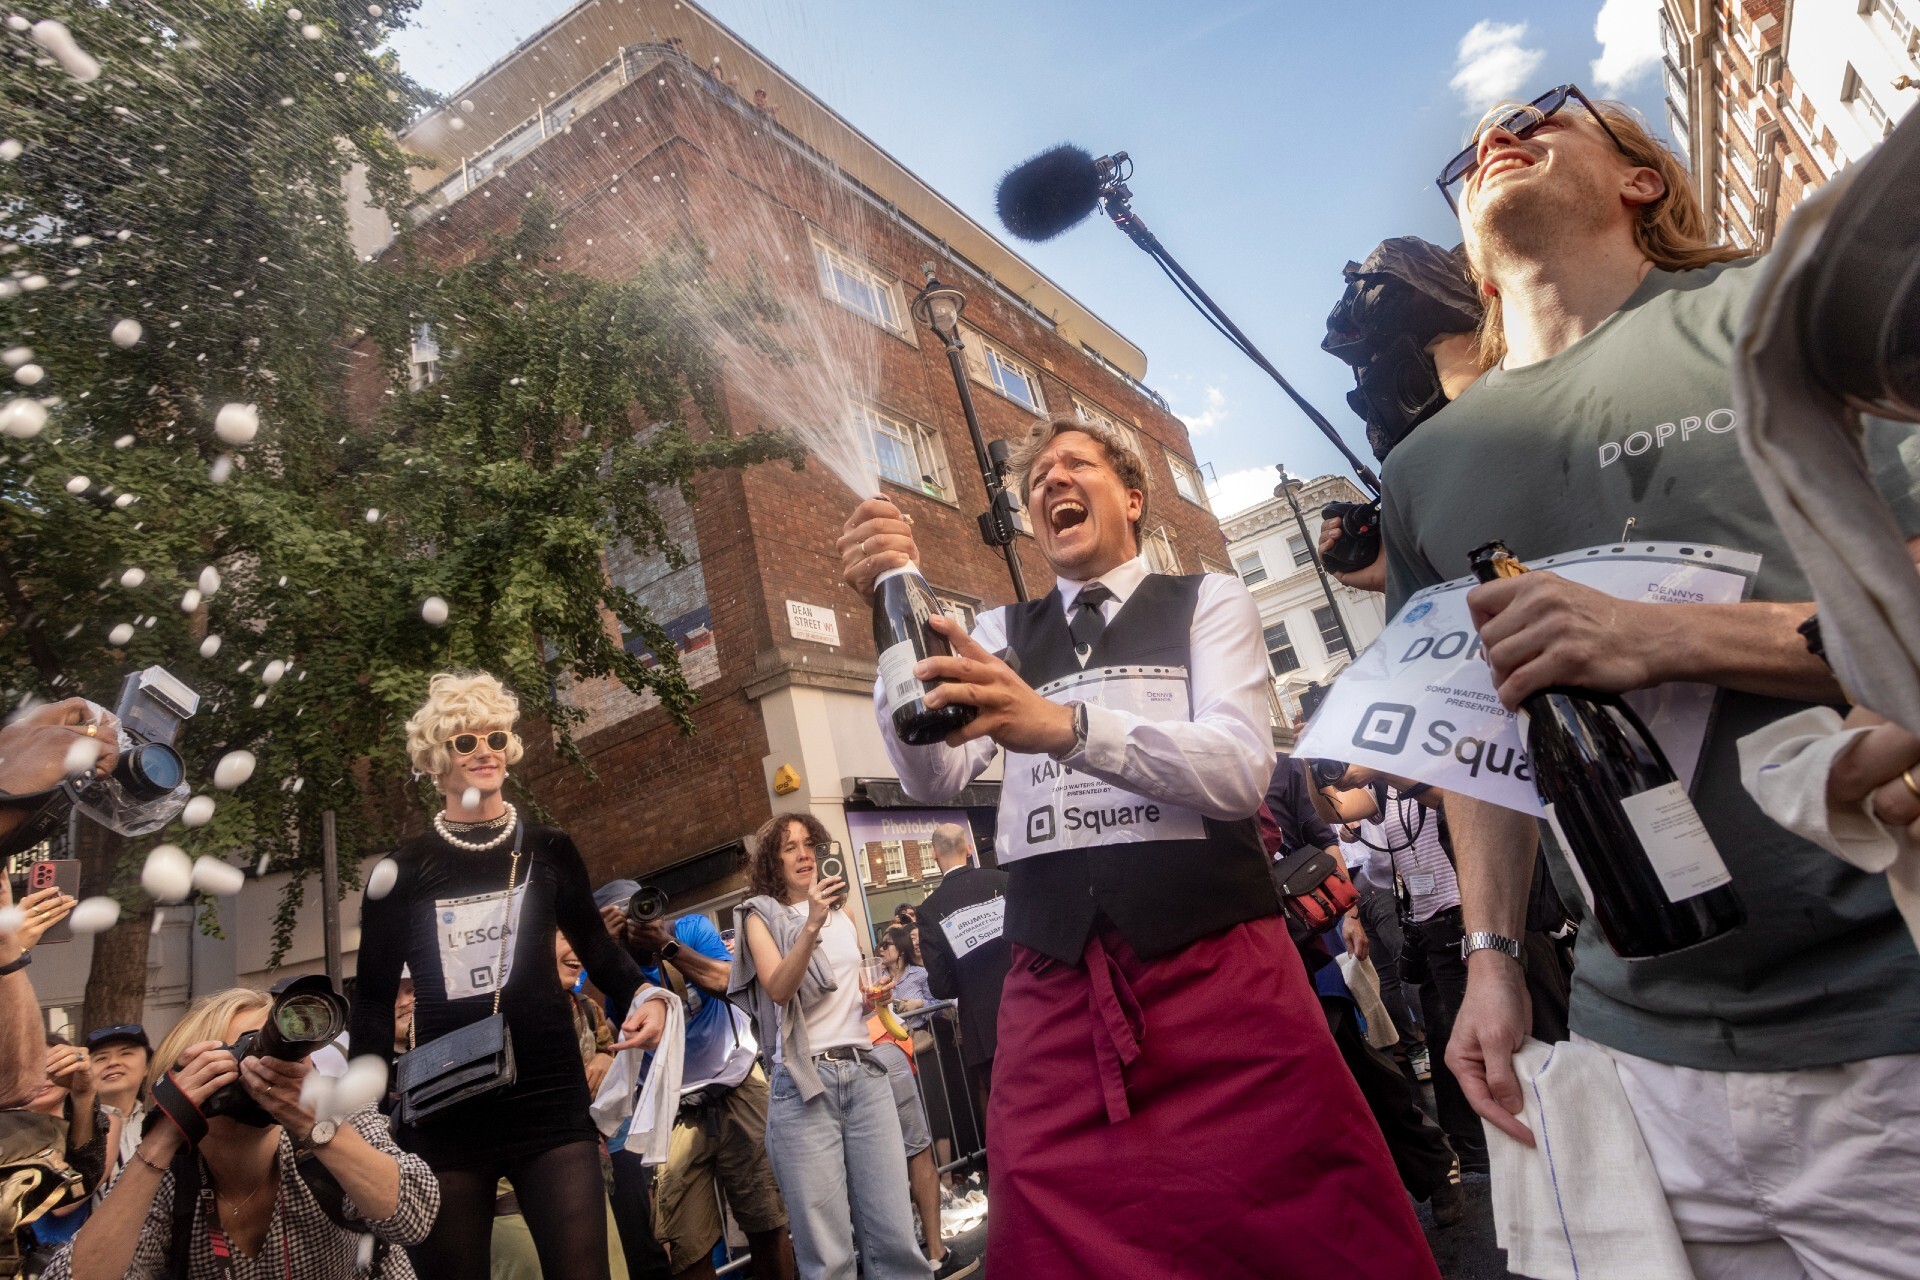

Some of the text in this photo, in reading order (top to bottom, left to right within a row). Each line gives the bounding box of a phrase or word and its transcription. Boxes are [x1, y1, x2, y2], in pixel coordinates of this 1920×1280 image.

[1599, 408, 1738, 468] DOPPO
[1648, 583, 1704, 602] DENNYS
[791, 604, 813, 618] DEAN
[794, 616, 834, 633] STREET W1
[1425, 685, 1452, 694] SOHO
[1453, 688, 1497, 703] WAITERS
[1445, 697, 1505, 717] PRESENTED
[1421, 719, 1532, 782] Squa
[1067, 788, 1103, 797] PRESENTED
[1068, 781, 1095, 790] WAITERS
[881, 817, 940, 835] PhotoLab
[1064, 804, 1160, 835] Square
[957, 912, 992, 930] BRUMUS
[989, 914, 1004, 923] HOTE
